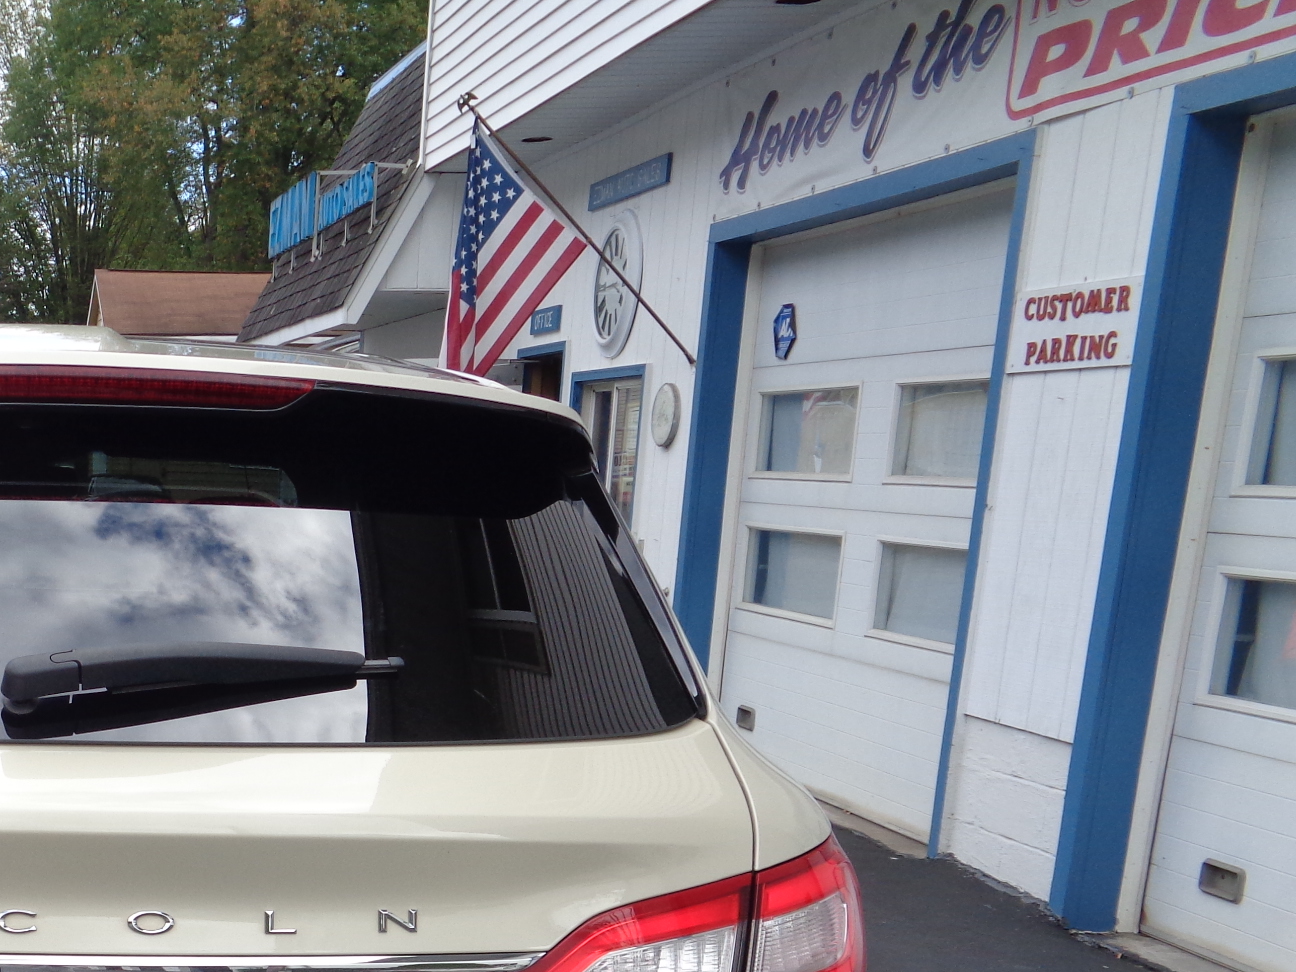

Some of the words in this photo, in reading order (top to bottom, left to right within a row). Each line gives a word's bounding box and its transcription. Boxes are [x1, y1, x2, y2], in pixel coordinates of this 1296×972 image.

[1017, 0, 1296, 100] PRIC
[719, 90, 848, 193] Home
[851, 22, 918, 164] of
[911, 0, 1013, 99] the
[534, 311, 553, 330] OFFICE
[1024, 285, 1131, 321] CUSTOMER
[1024, 331, 1118, 365] PARKING
